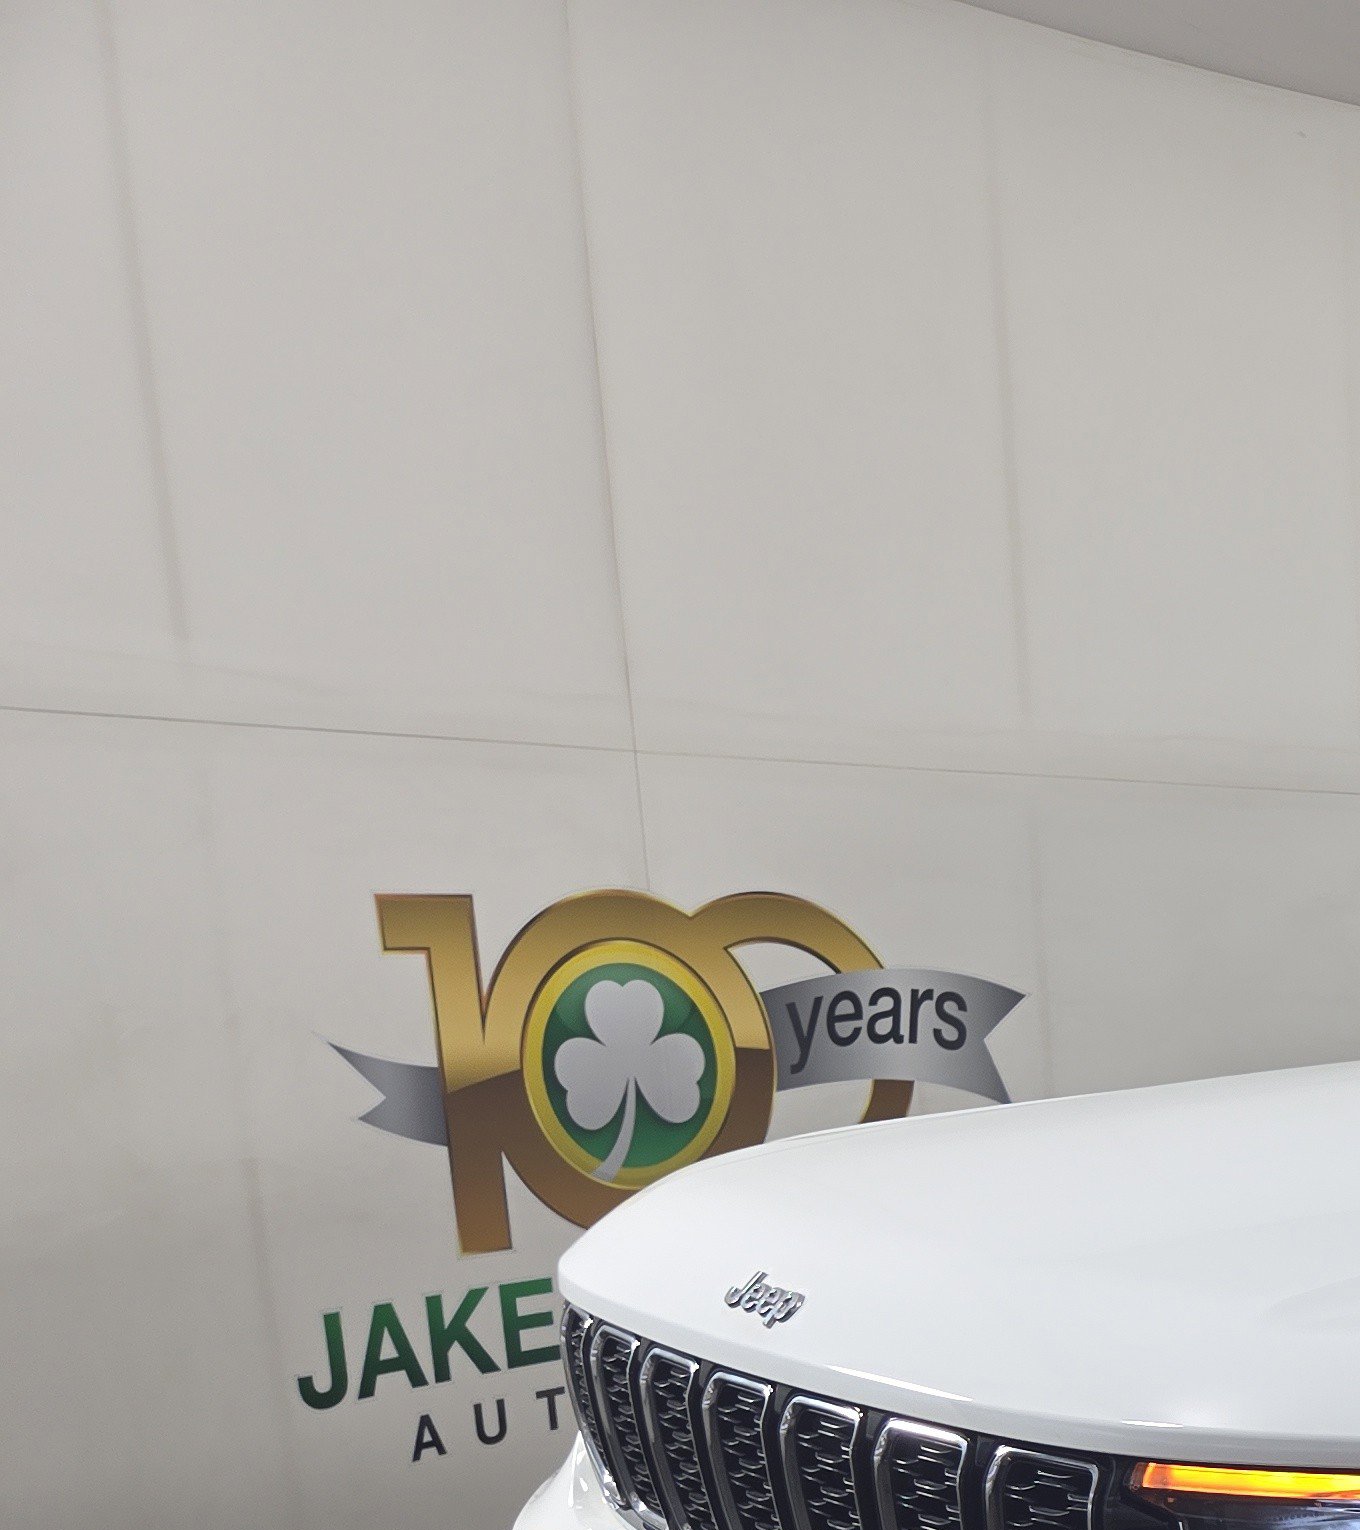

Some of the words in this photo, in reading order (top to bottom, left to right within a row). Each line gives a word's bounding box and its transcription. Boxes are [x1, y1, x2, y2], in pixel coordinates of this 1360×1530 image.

[785, 986, 968, 1074] years
[297, 1277, 560, 1410] JAKE
[724, 1270, 805, 1329] Jeep
